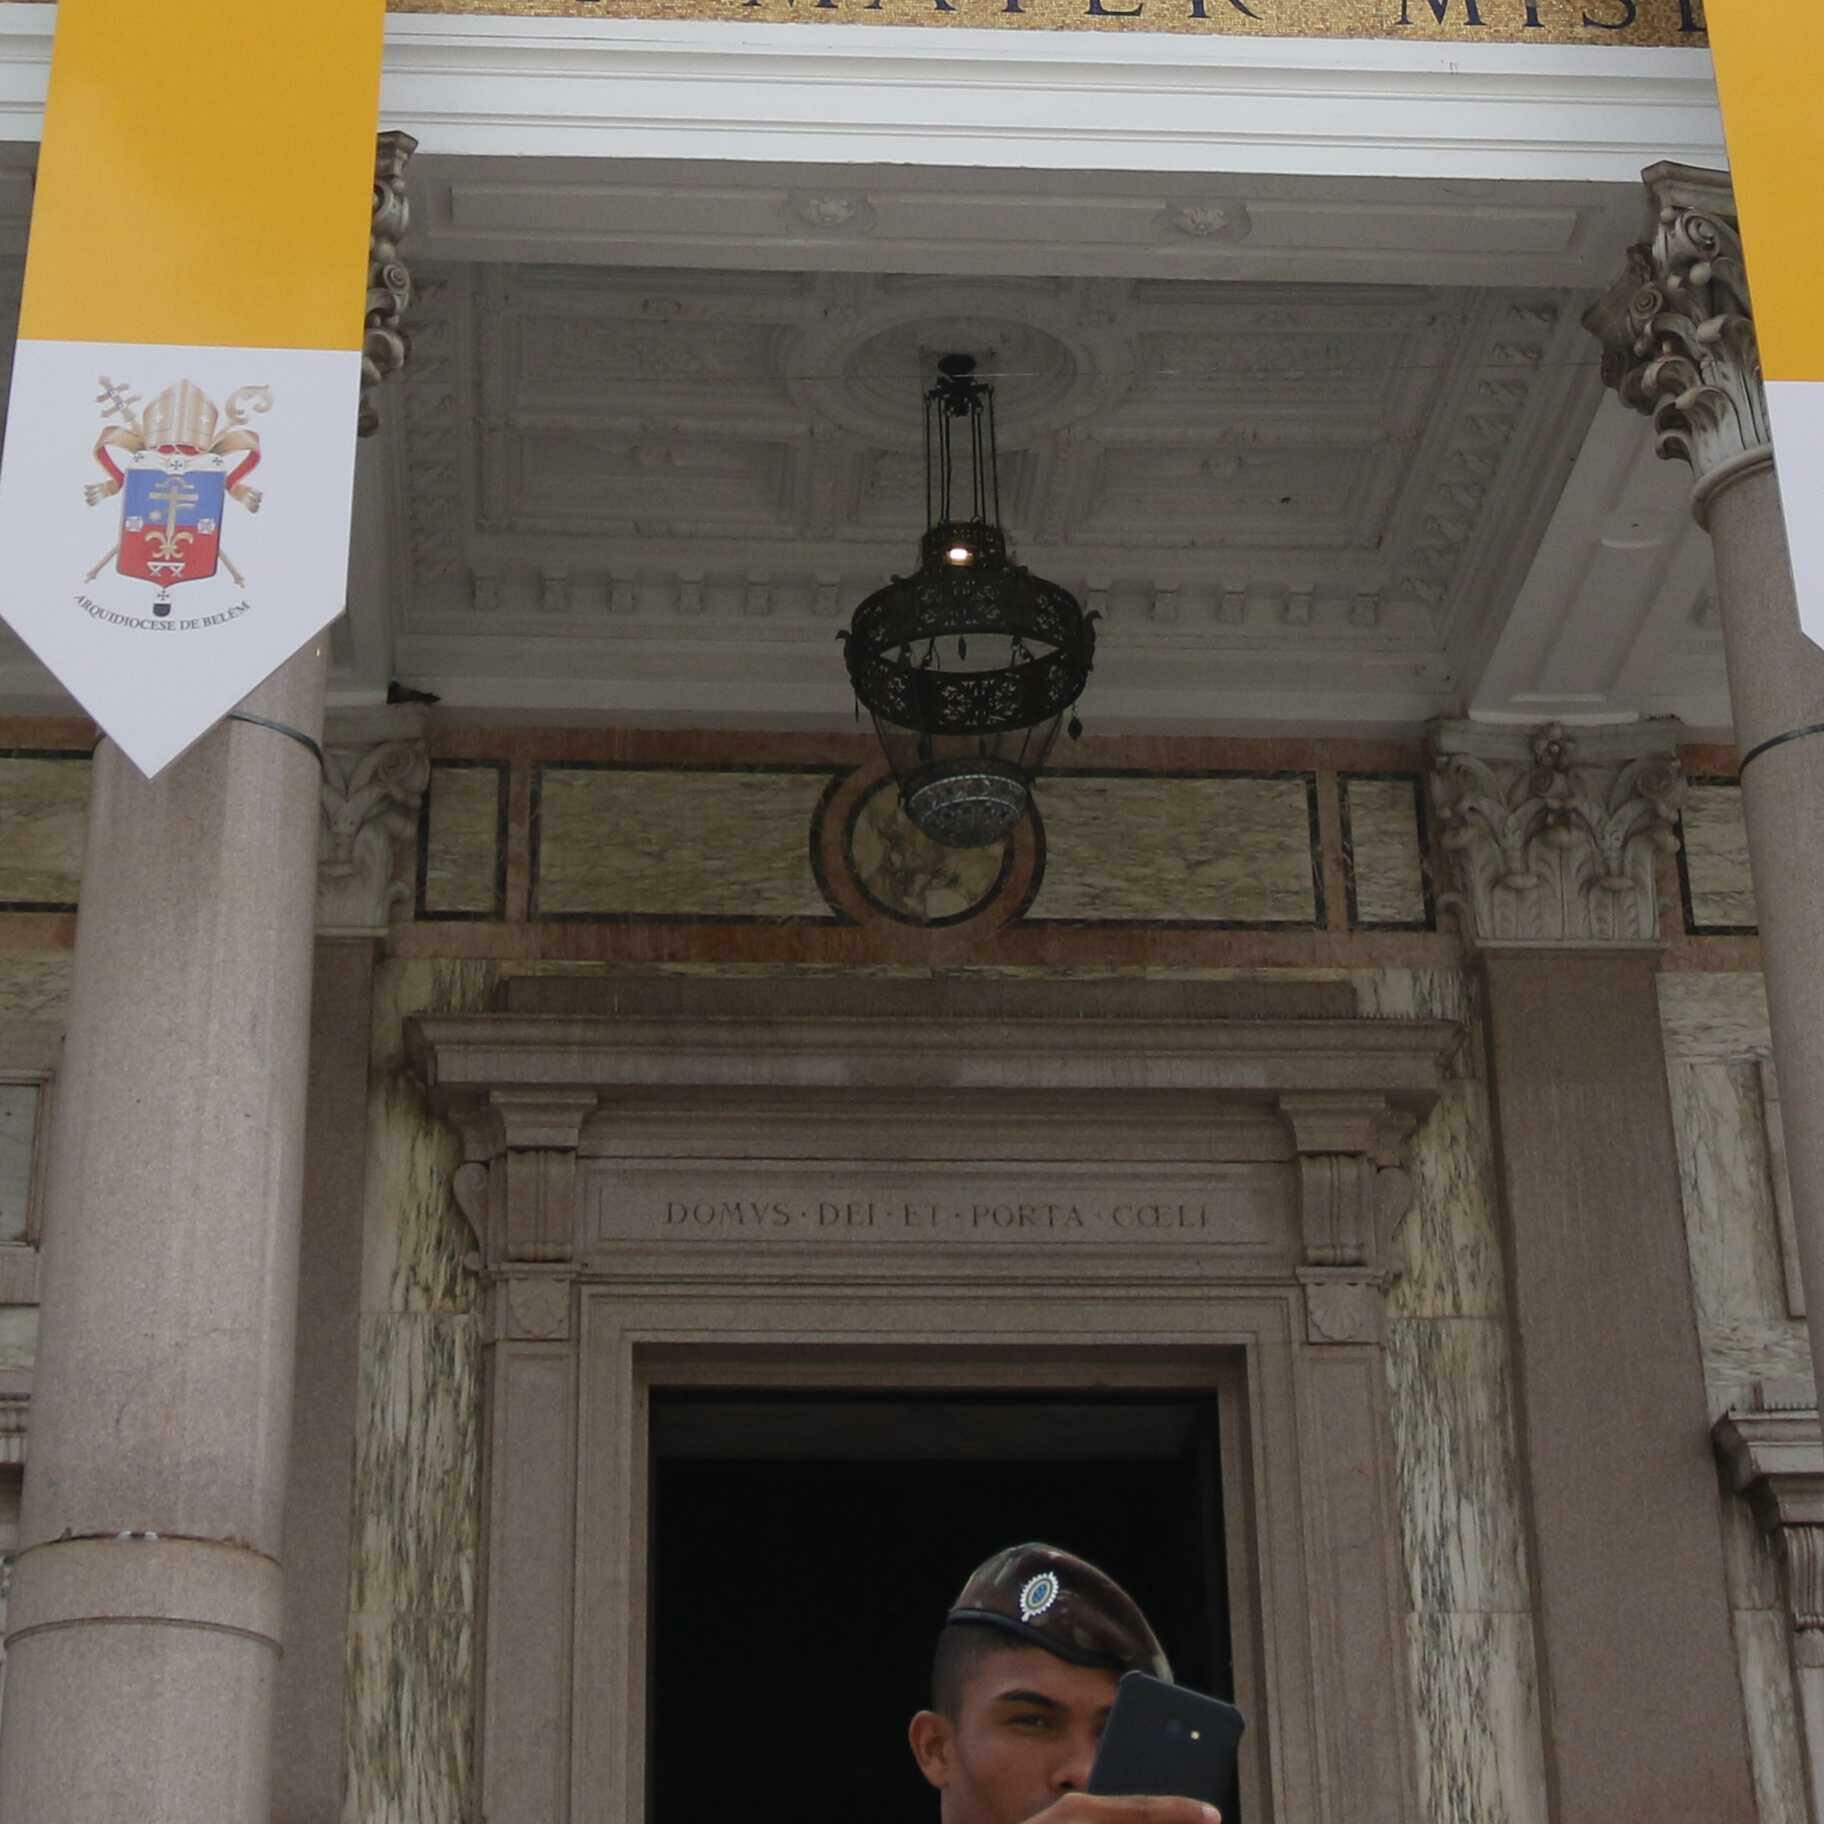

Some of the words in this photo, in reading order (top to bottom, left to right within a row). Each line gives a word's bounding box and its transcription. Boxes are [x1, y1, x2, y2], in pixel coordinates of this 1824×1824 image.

[73, 593, 175, 631] ARQUIDIOCESE
[179, 619, 200, 631] DE
[203, 600, 251, 628] BELÉM
[664, 1201, 790, 1226] DOMVS
[819, 1202, 874, 1226] DEI
[904, 1203, 941, 1227] ET
[972, 1203, 1084, 1227] PORTA
